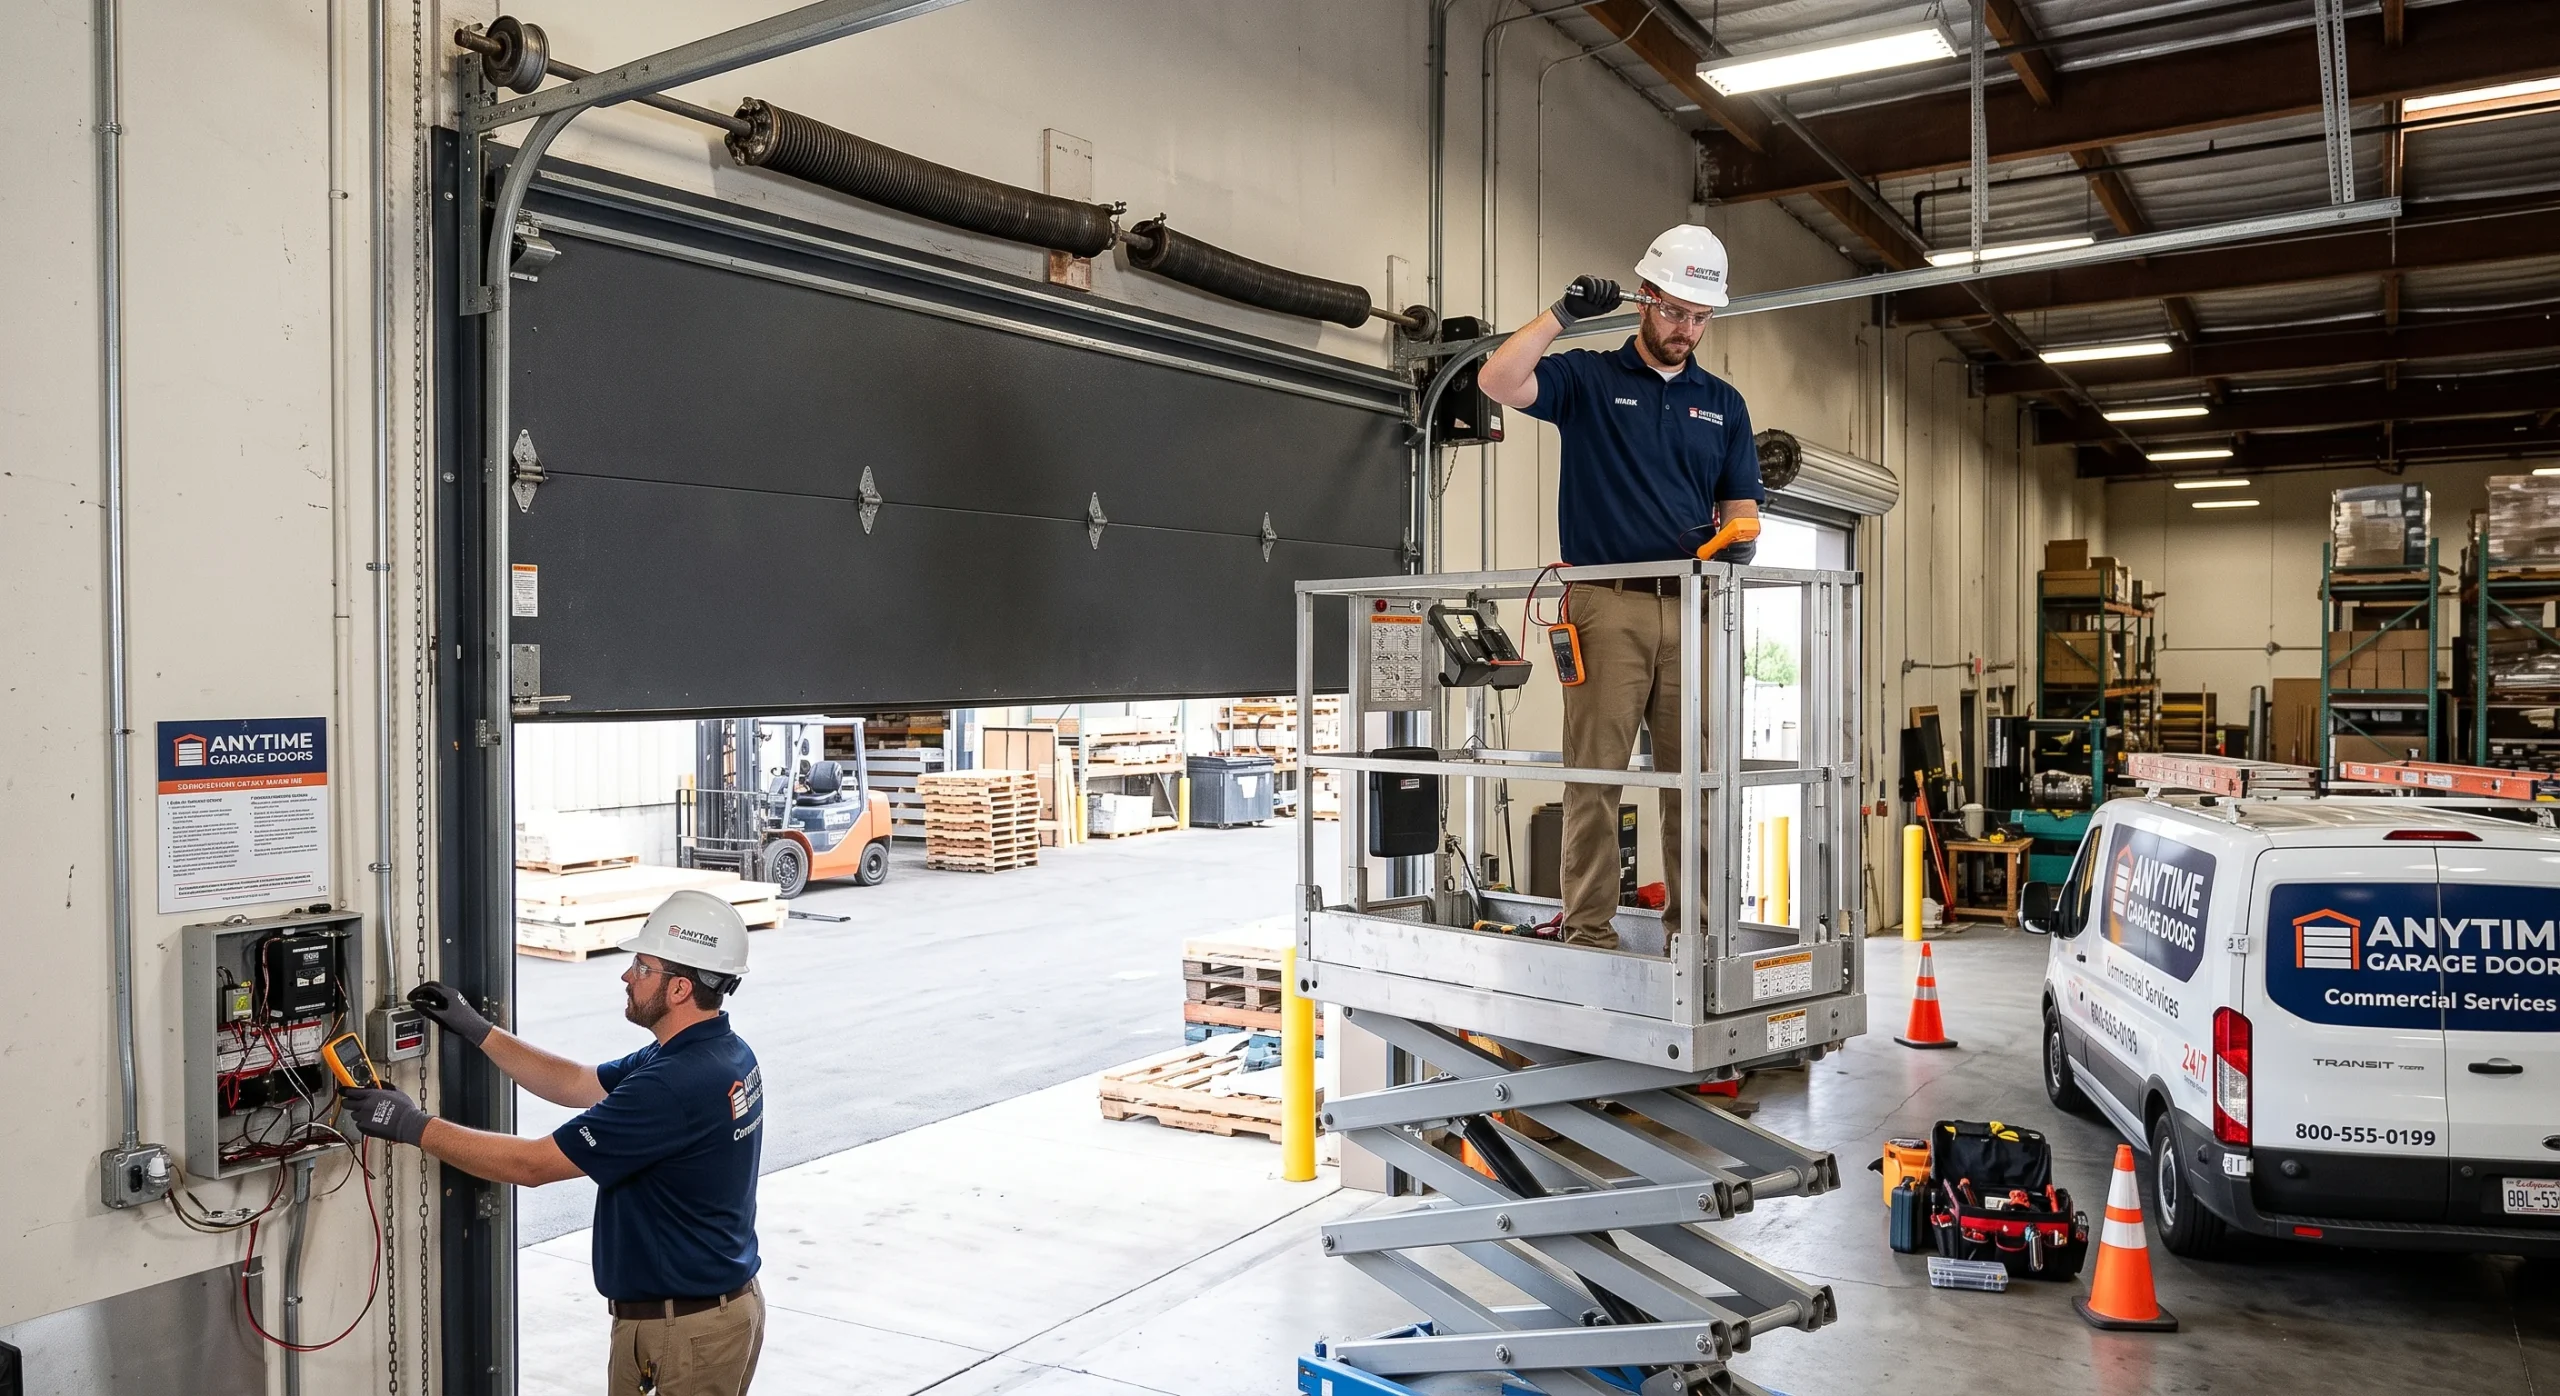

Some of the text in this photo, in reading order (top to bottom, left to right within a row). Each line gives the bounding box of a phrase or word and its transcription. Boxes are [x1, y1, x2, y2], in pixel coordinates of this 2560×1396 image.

[209, 732, 313, 753] ANYTIME
[209, 751, 313, 766] GARAGE DOORS
[2129, 854, 2205, 919] ANYTIME
[2126, 899, 2197, 952] GARAGE DOORS
[2366, 916, 2560, 951] ANYTIM
[2366, 953, 2477, 974] GARAGE
[2145, 979, 2179, 1019] Services
[2324, 988, 2557, 1012] Commercial Services
[2182, 1043, 2207, 1082] 24/7
[2312, 1058, 2395, 1069] TRANSIT
[2295, 1123, 2436, 1146] 800-555-0199
